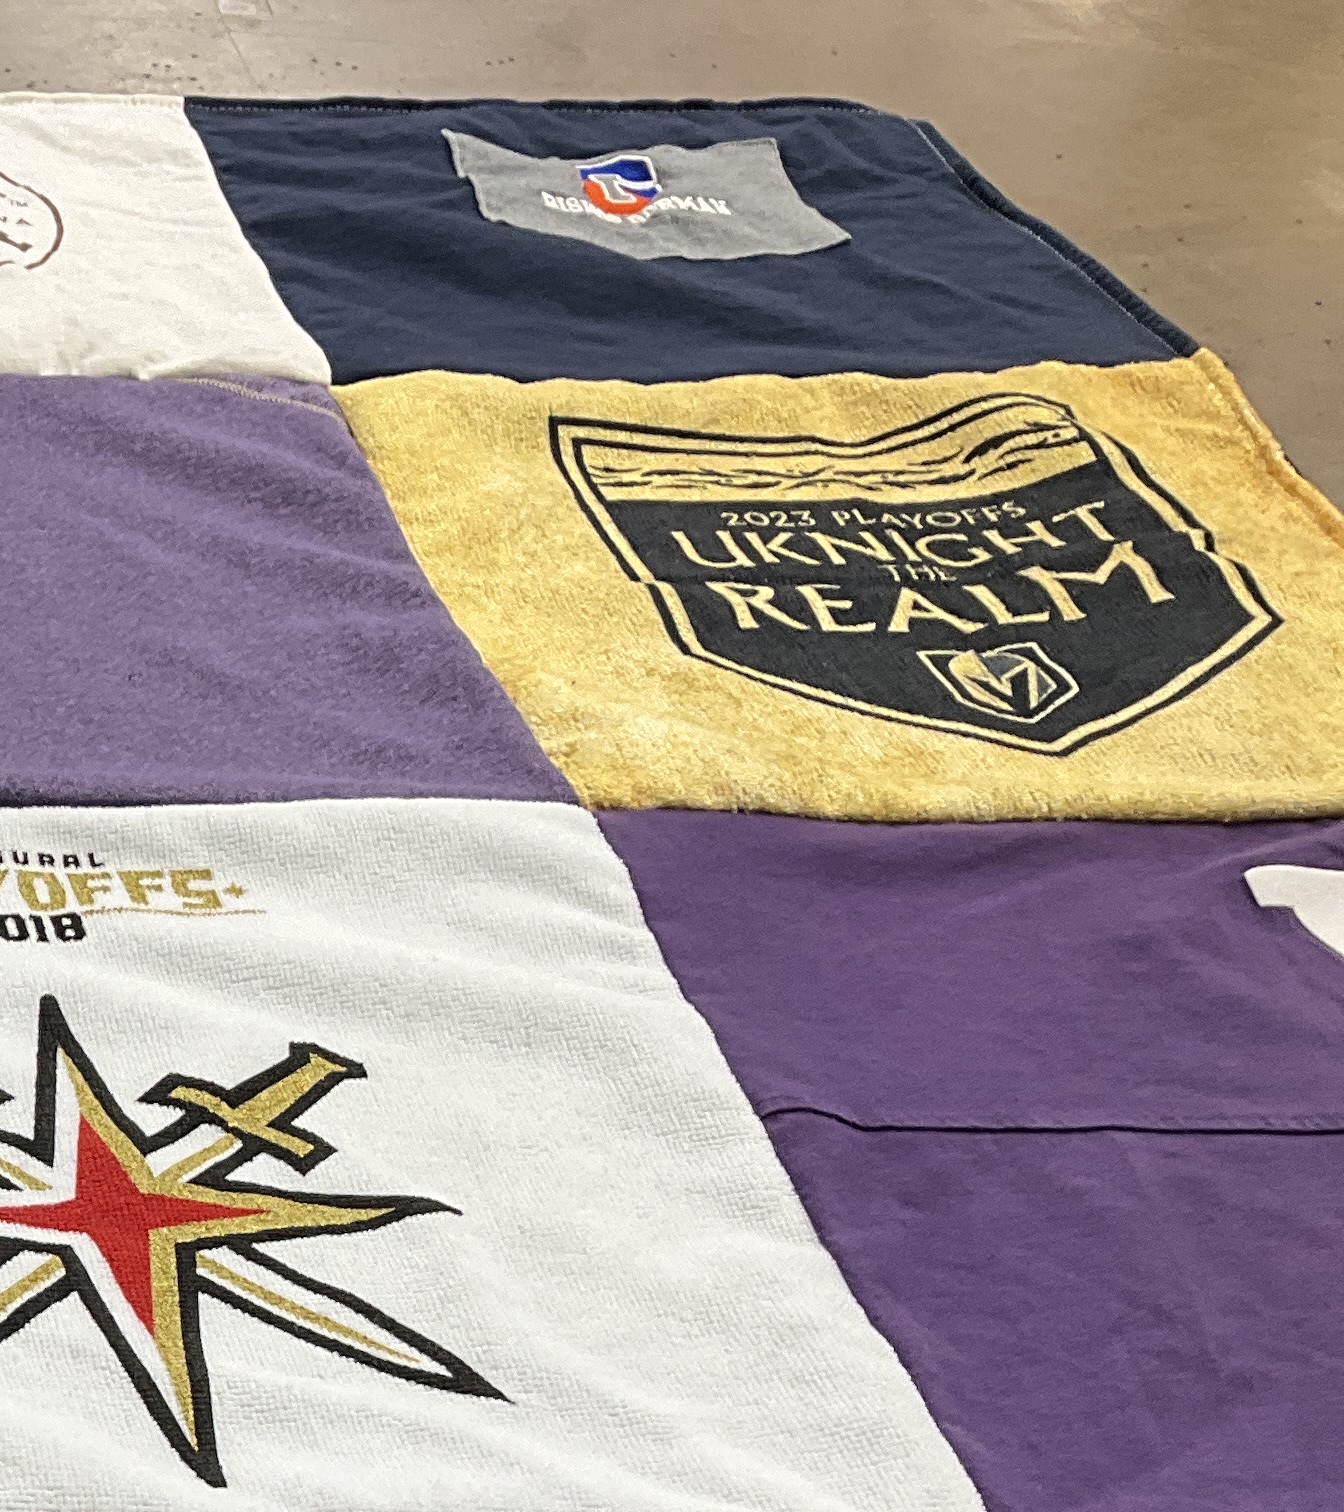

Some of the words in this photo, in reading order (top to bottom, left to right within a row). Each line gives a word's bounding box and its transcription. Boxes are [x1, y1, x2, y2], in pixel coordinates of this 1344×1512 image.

[671, 500, 1116, 568] UKNIGHT
[720, 509, 817, 528] 2023
[831, 501, 1027, 531] PLAYOFFS
[704, 539, 1177, 634] REALM
[878, 562, 959, 584] THE
